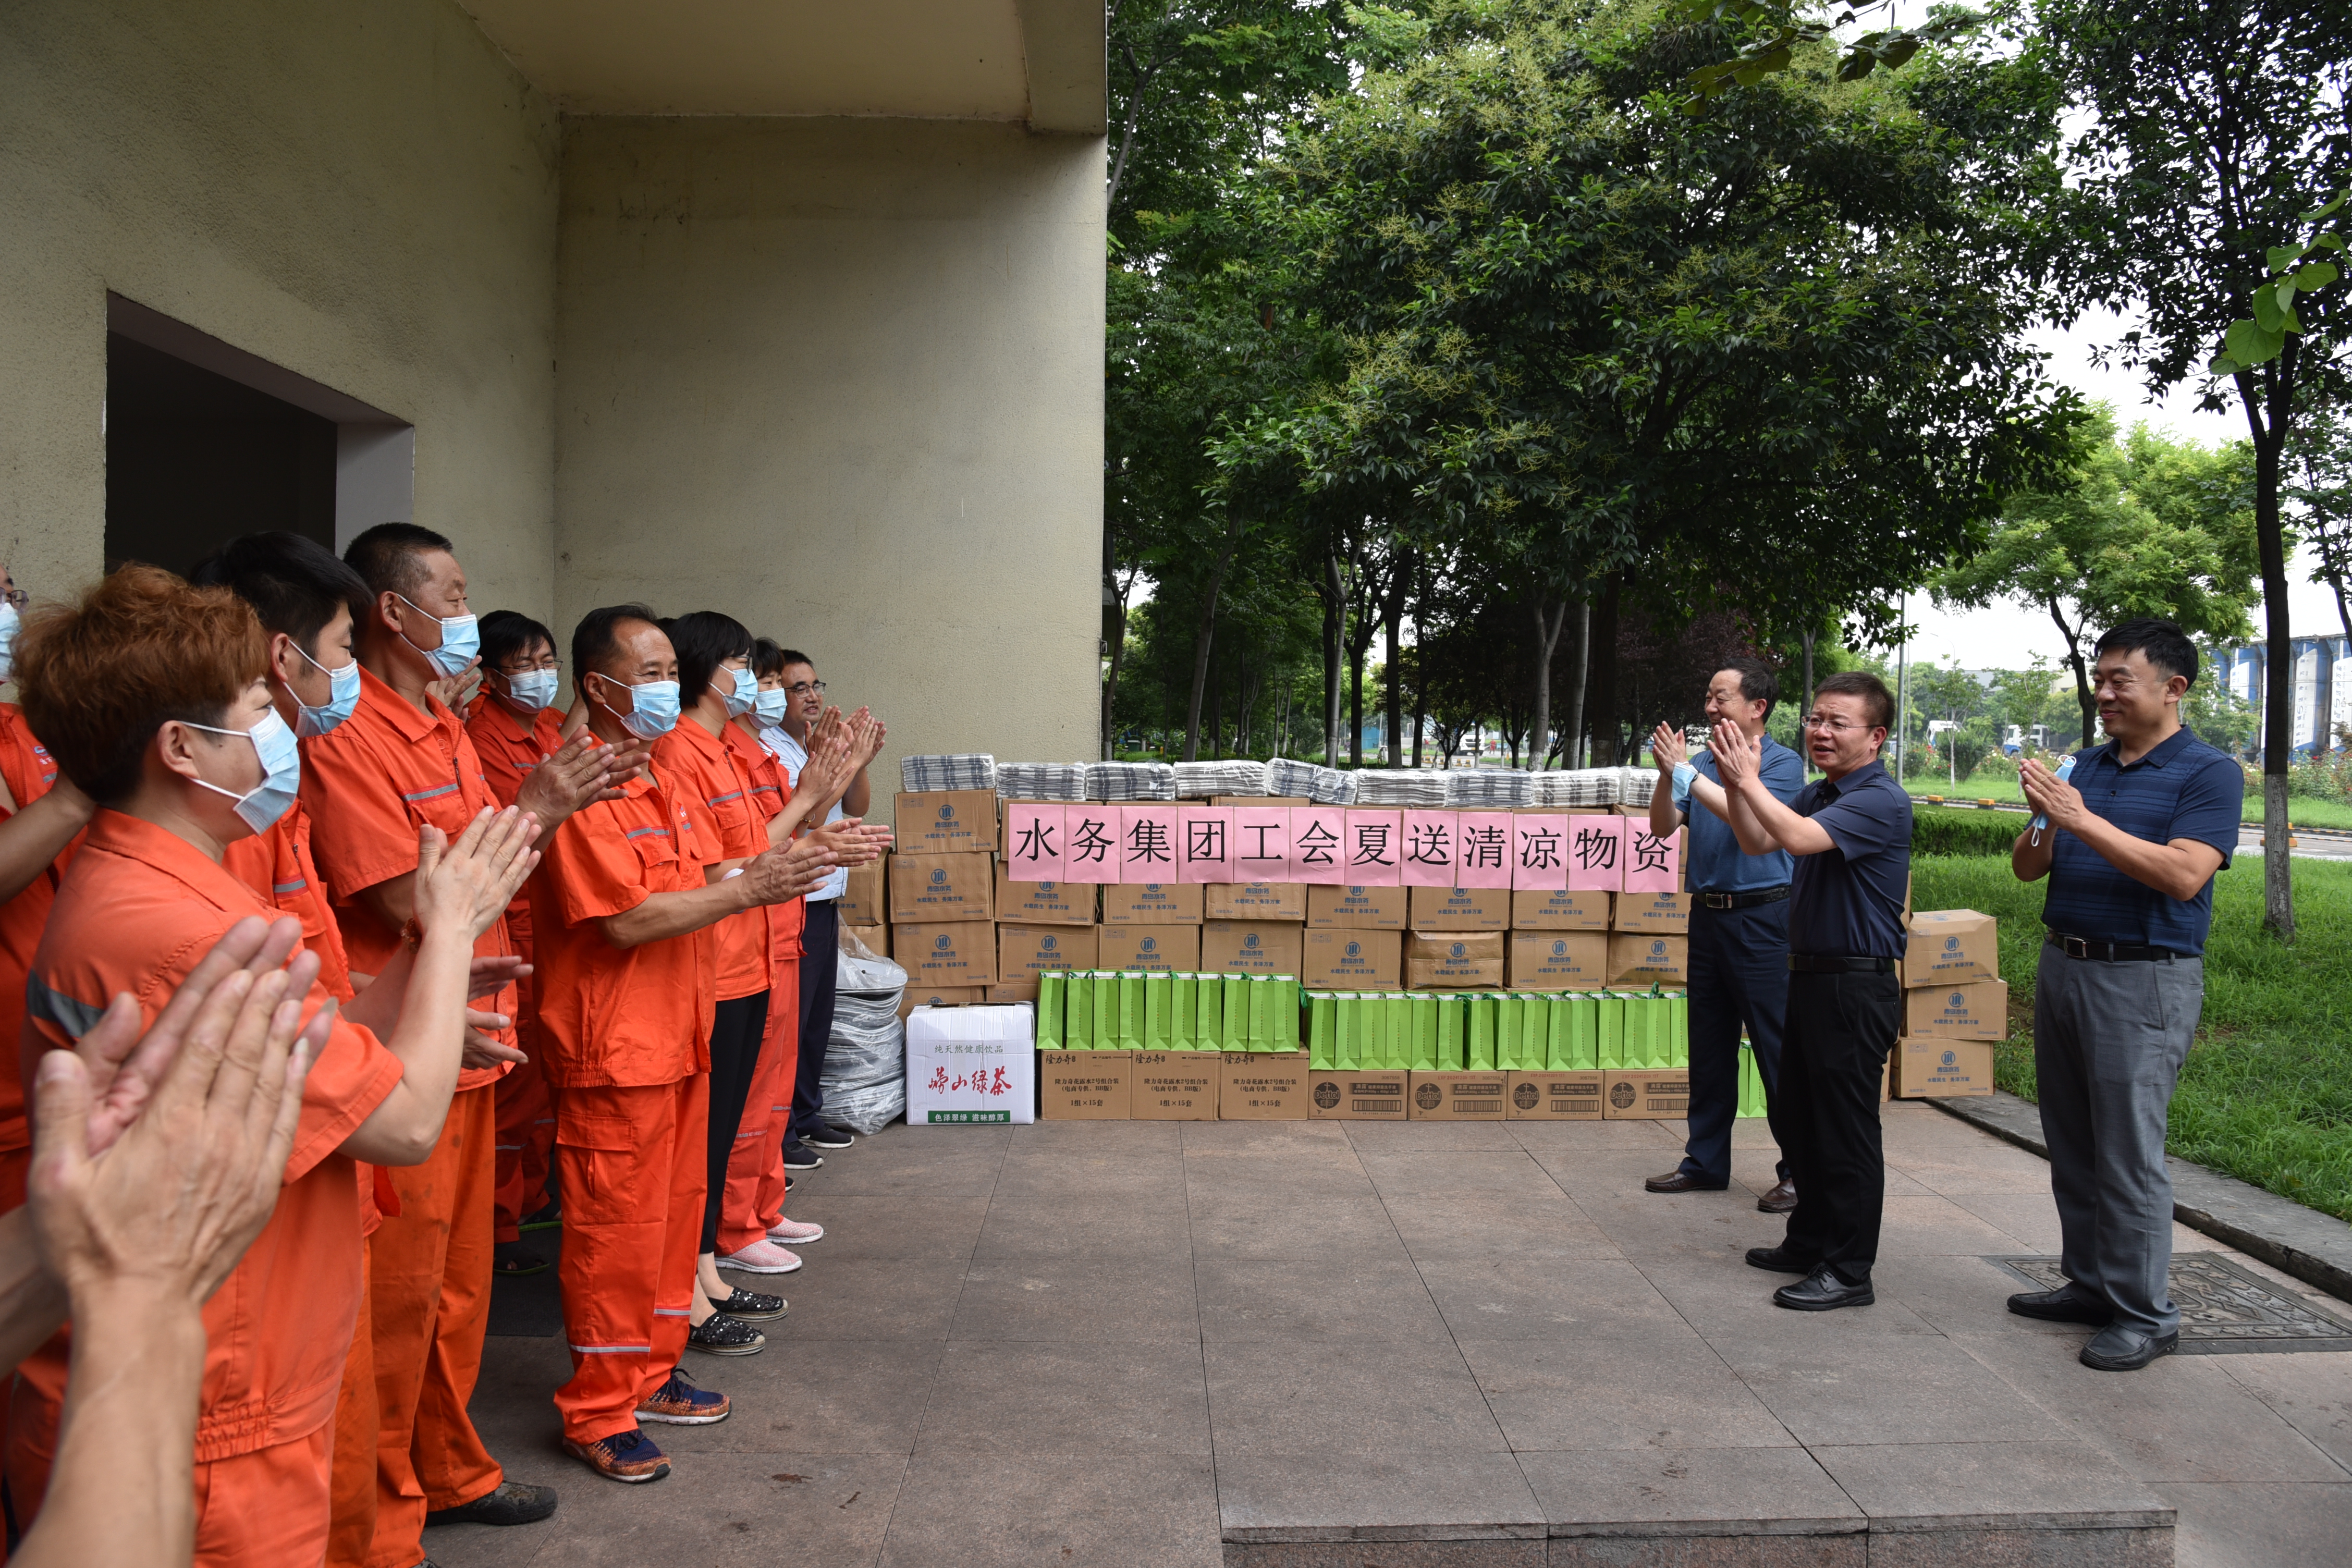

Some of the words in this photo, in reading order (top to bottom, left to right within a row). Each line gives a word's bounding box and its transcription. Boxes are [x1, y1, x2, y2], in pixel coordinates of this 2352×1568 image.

[1014, 816, 1673, 873] 水务集团工会夏送清凉物资
[934, 1044, 1003, 1054] 纯天然健康饮品
[928, 1065, 1012, 1096] 崂山绿茶
[1314, 1089, 1340, 1099] Dettol
[1415, 1091, 1441, 1100] Dettol
[1514, 1091, 1538, 1100] Dettol
[1610, 1090, 1635, 1099] Dettol
[972, 1113, 1005, 1121] 滋味醇厚
